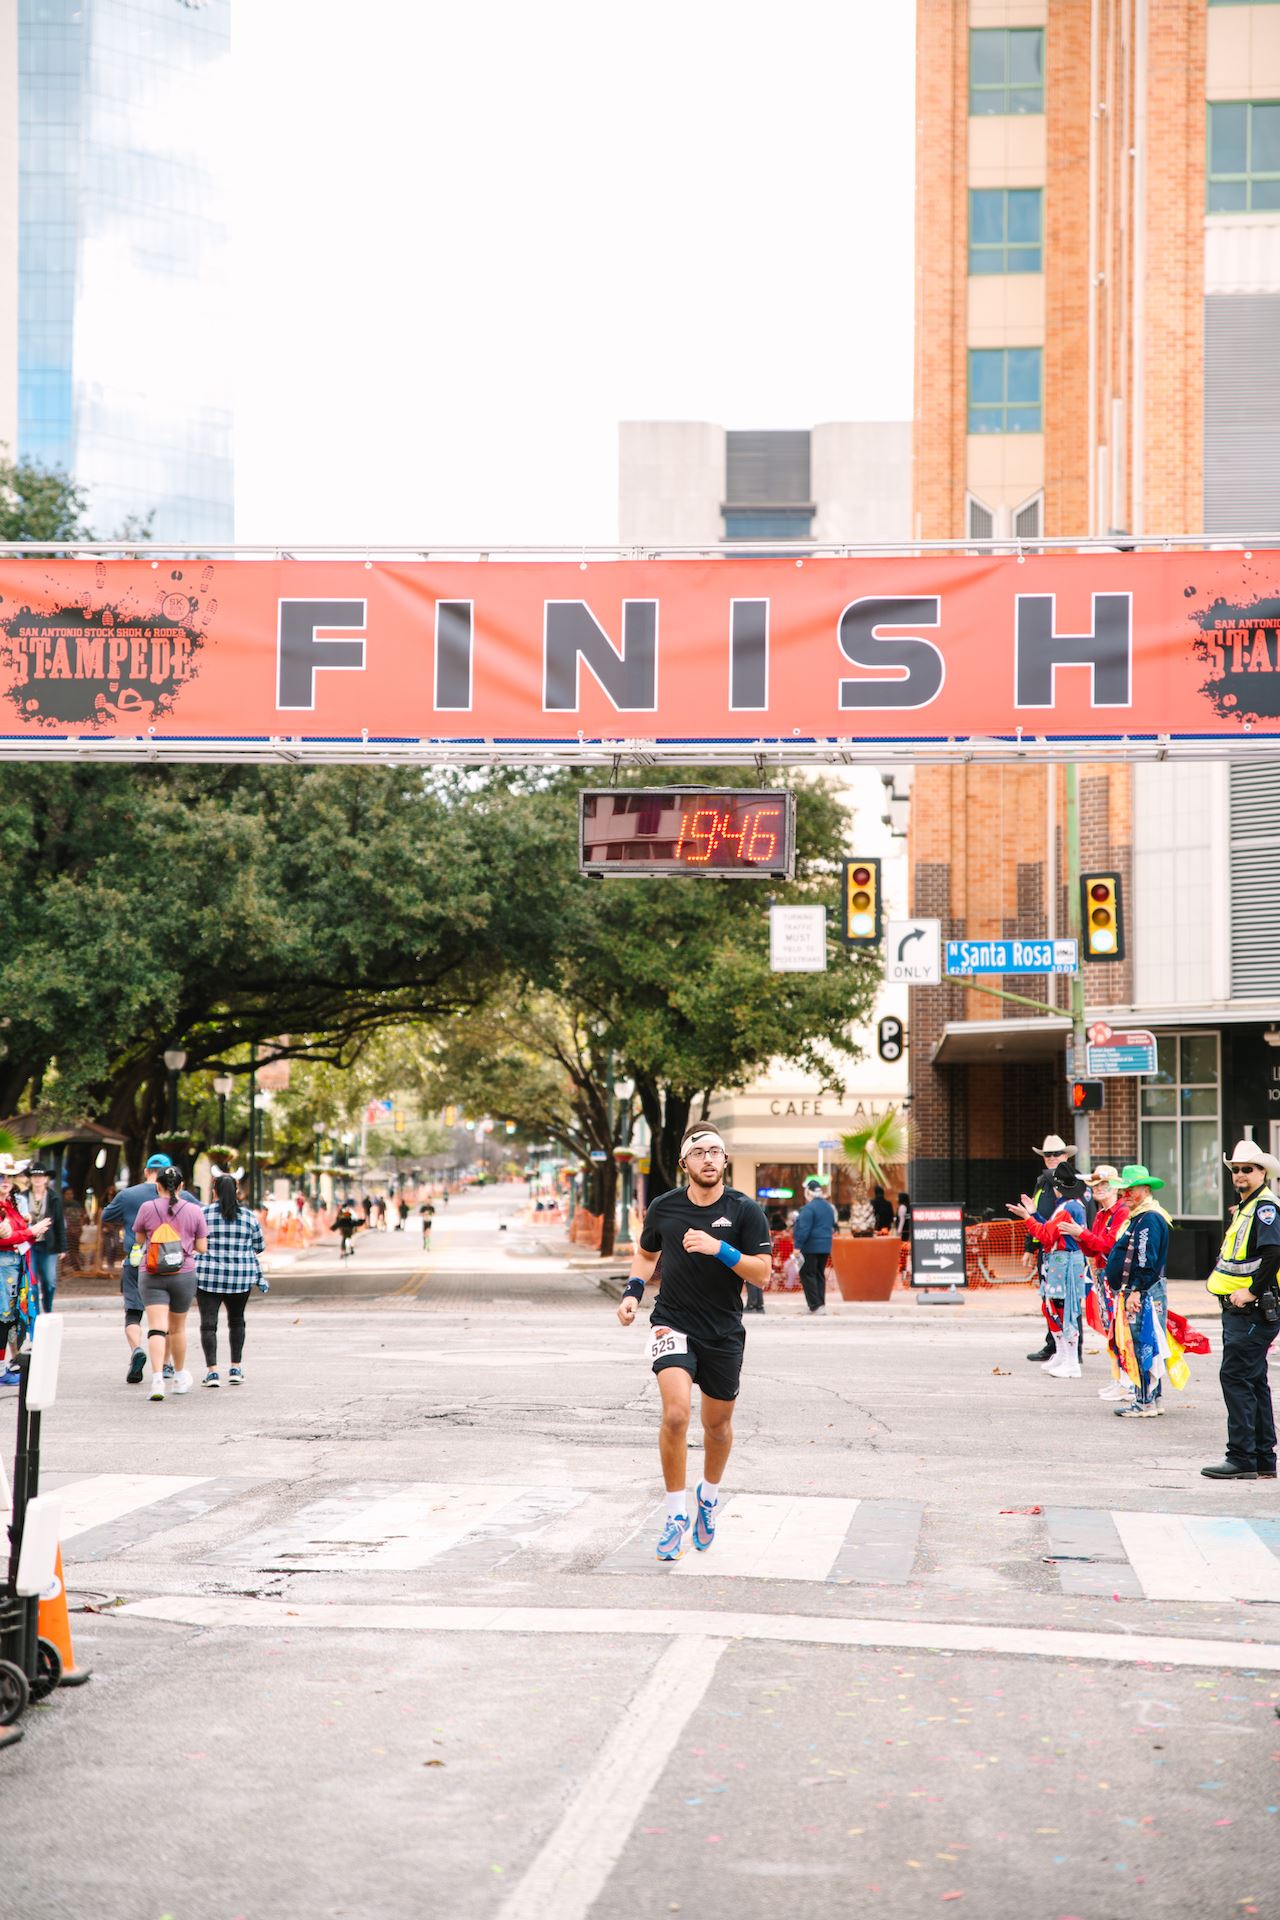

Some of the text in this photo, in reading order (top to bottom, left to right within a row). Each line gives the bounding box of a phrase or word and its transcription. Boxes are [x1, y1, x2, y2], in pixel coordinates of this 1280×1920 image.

[1214, 619, 1235, 629] SAN
[19, 628, 40, 637] SAN
[41, 628, 83, 637] ANTONIO
[84, 628, 115, 637] STOCK
[116, 628, 142, 638] SHOW
[144, 628, 151, 637] &
[275, 590, 1134, 713] FINISH
[11, 637, 192, 684] STAMPEDE
[950, 942, 1052, 967] N Santa Rosa
[894, 966, 932, 978] ONLY
[770, 1100, 823, 1116] CAFE
[913, 1228, 962, 1240] MARKET SQUARE
[934, 1243, 962, 1254] PARKING
[651, 1337, 675, 1357] 525
